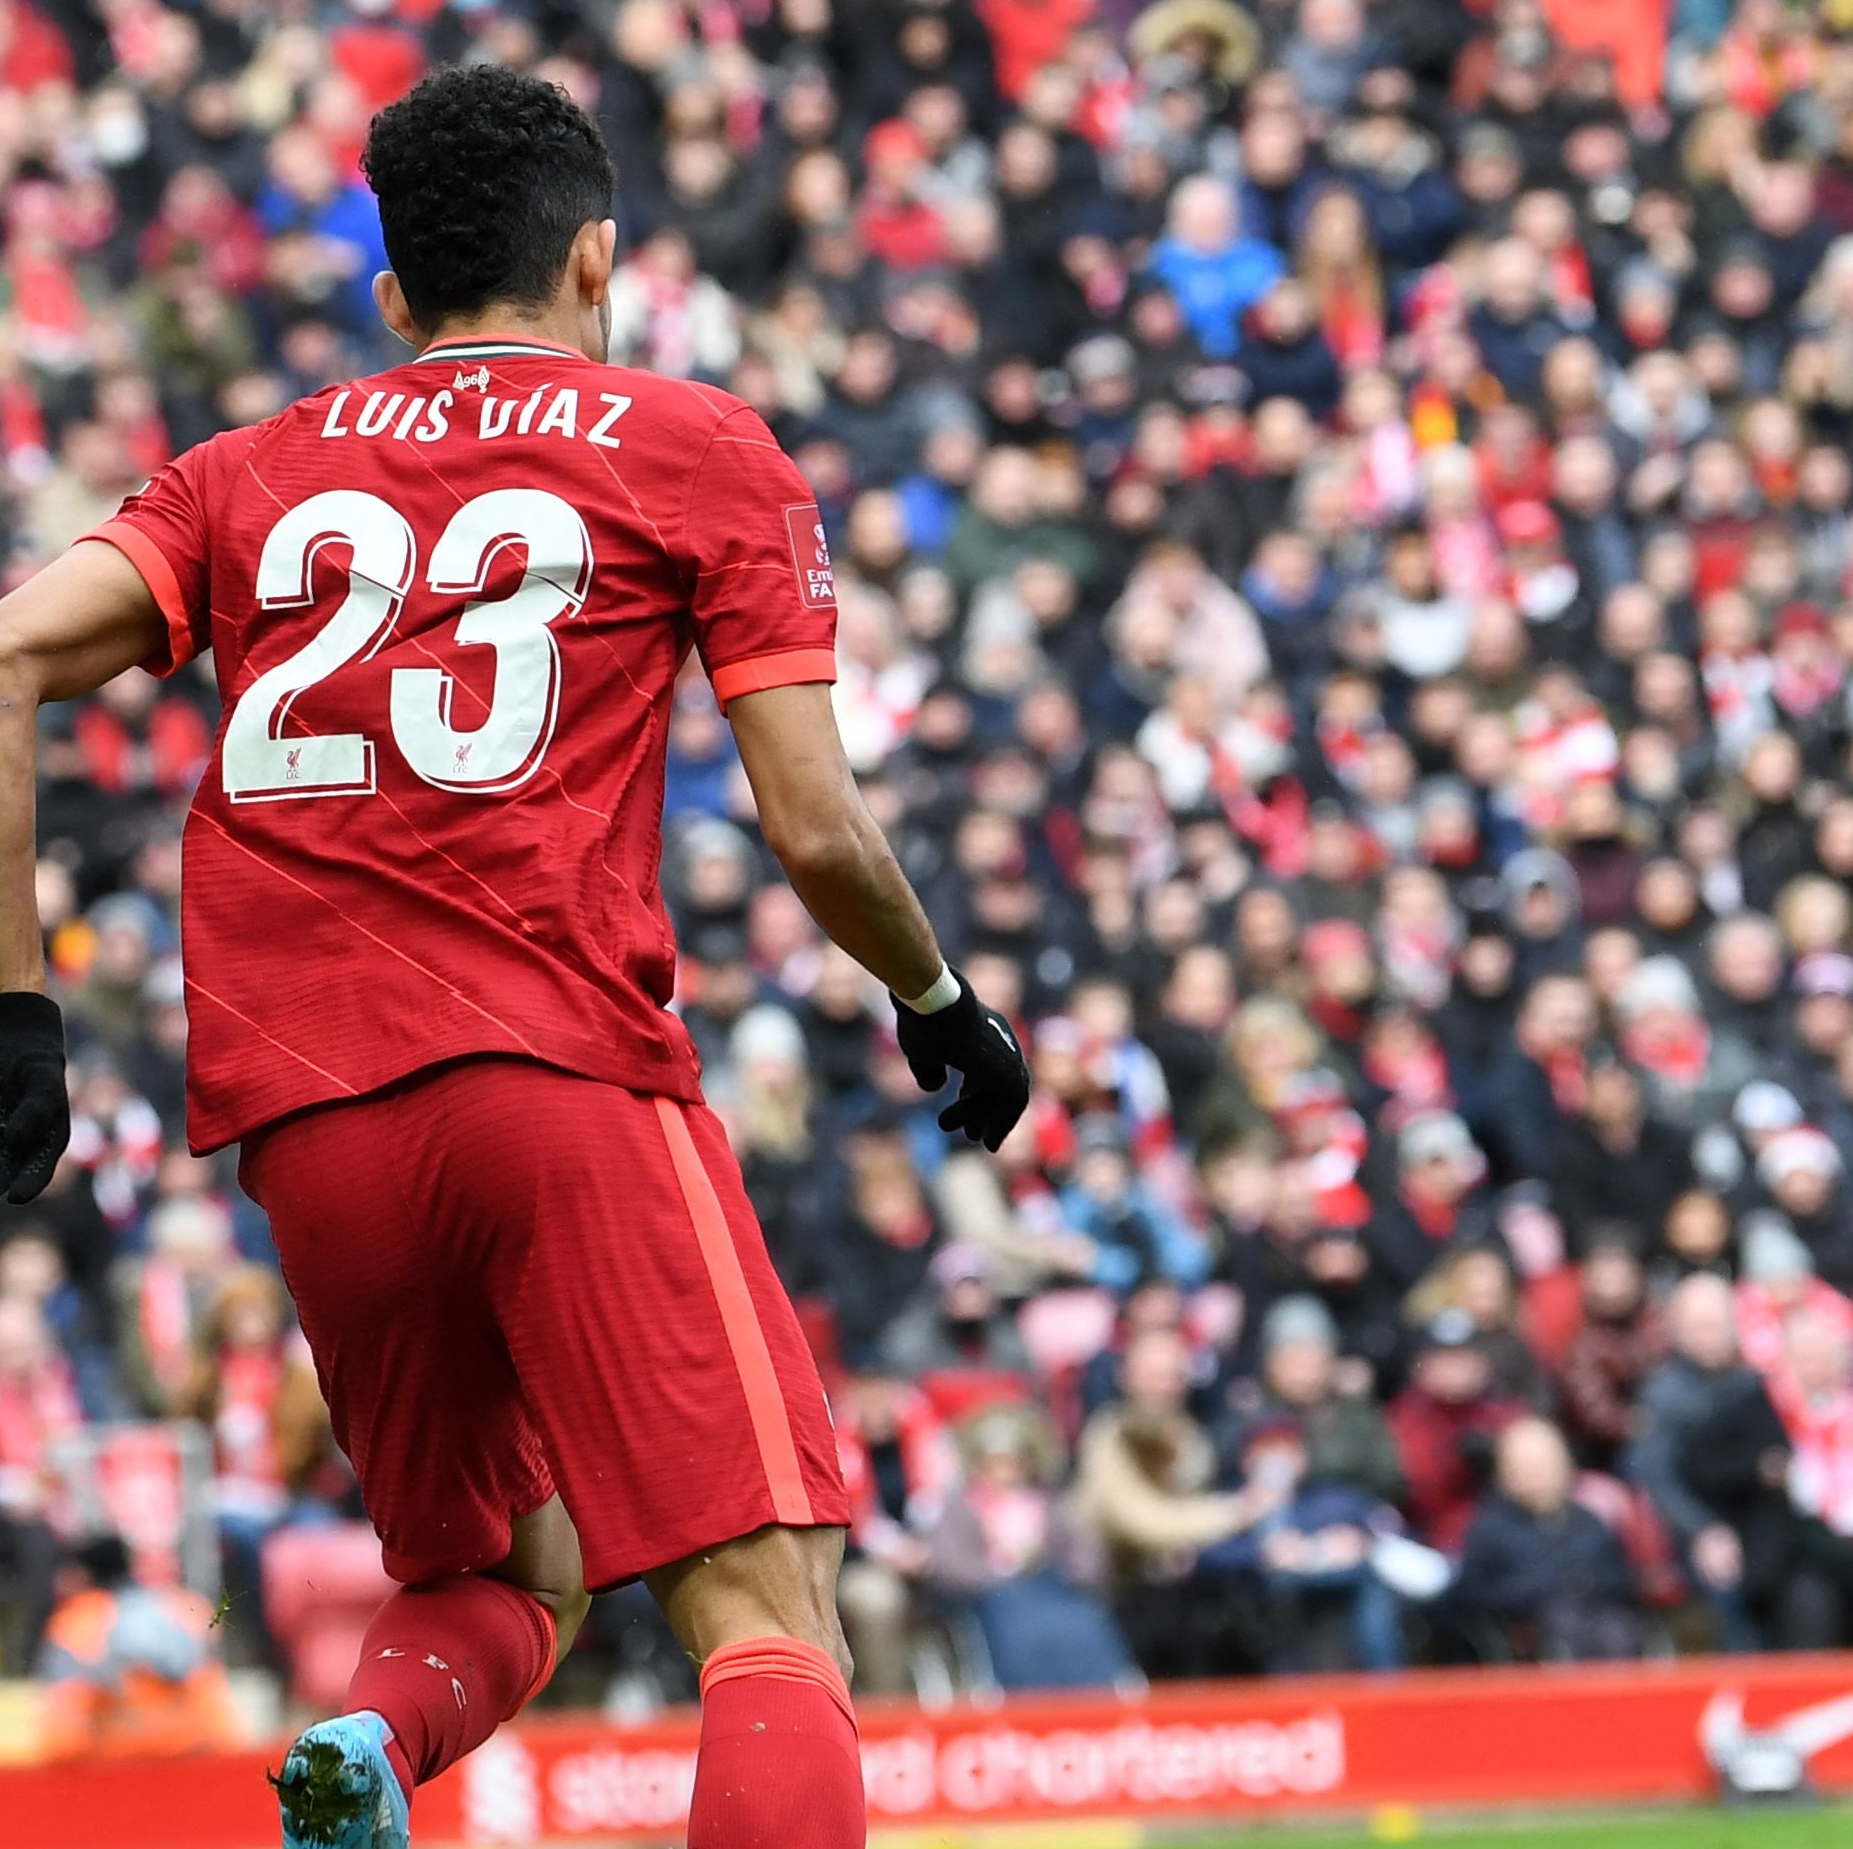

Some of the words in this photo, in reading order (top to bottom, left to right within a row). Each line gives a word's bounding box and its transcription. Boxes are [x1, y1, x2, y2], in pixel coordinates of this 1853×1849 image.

[320, 389, 454, 443] LUIS
[478, 381, 633, 449] DÍAZ
[463, 375, 478, 388] 96
[809, 582, 833, 599] FA
[222, 488, 595, 803] 23
[941, 1706, 1346, 1813] chartered
